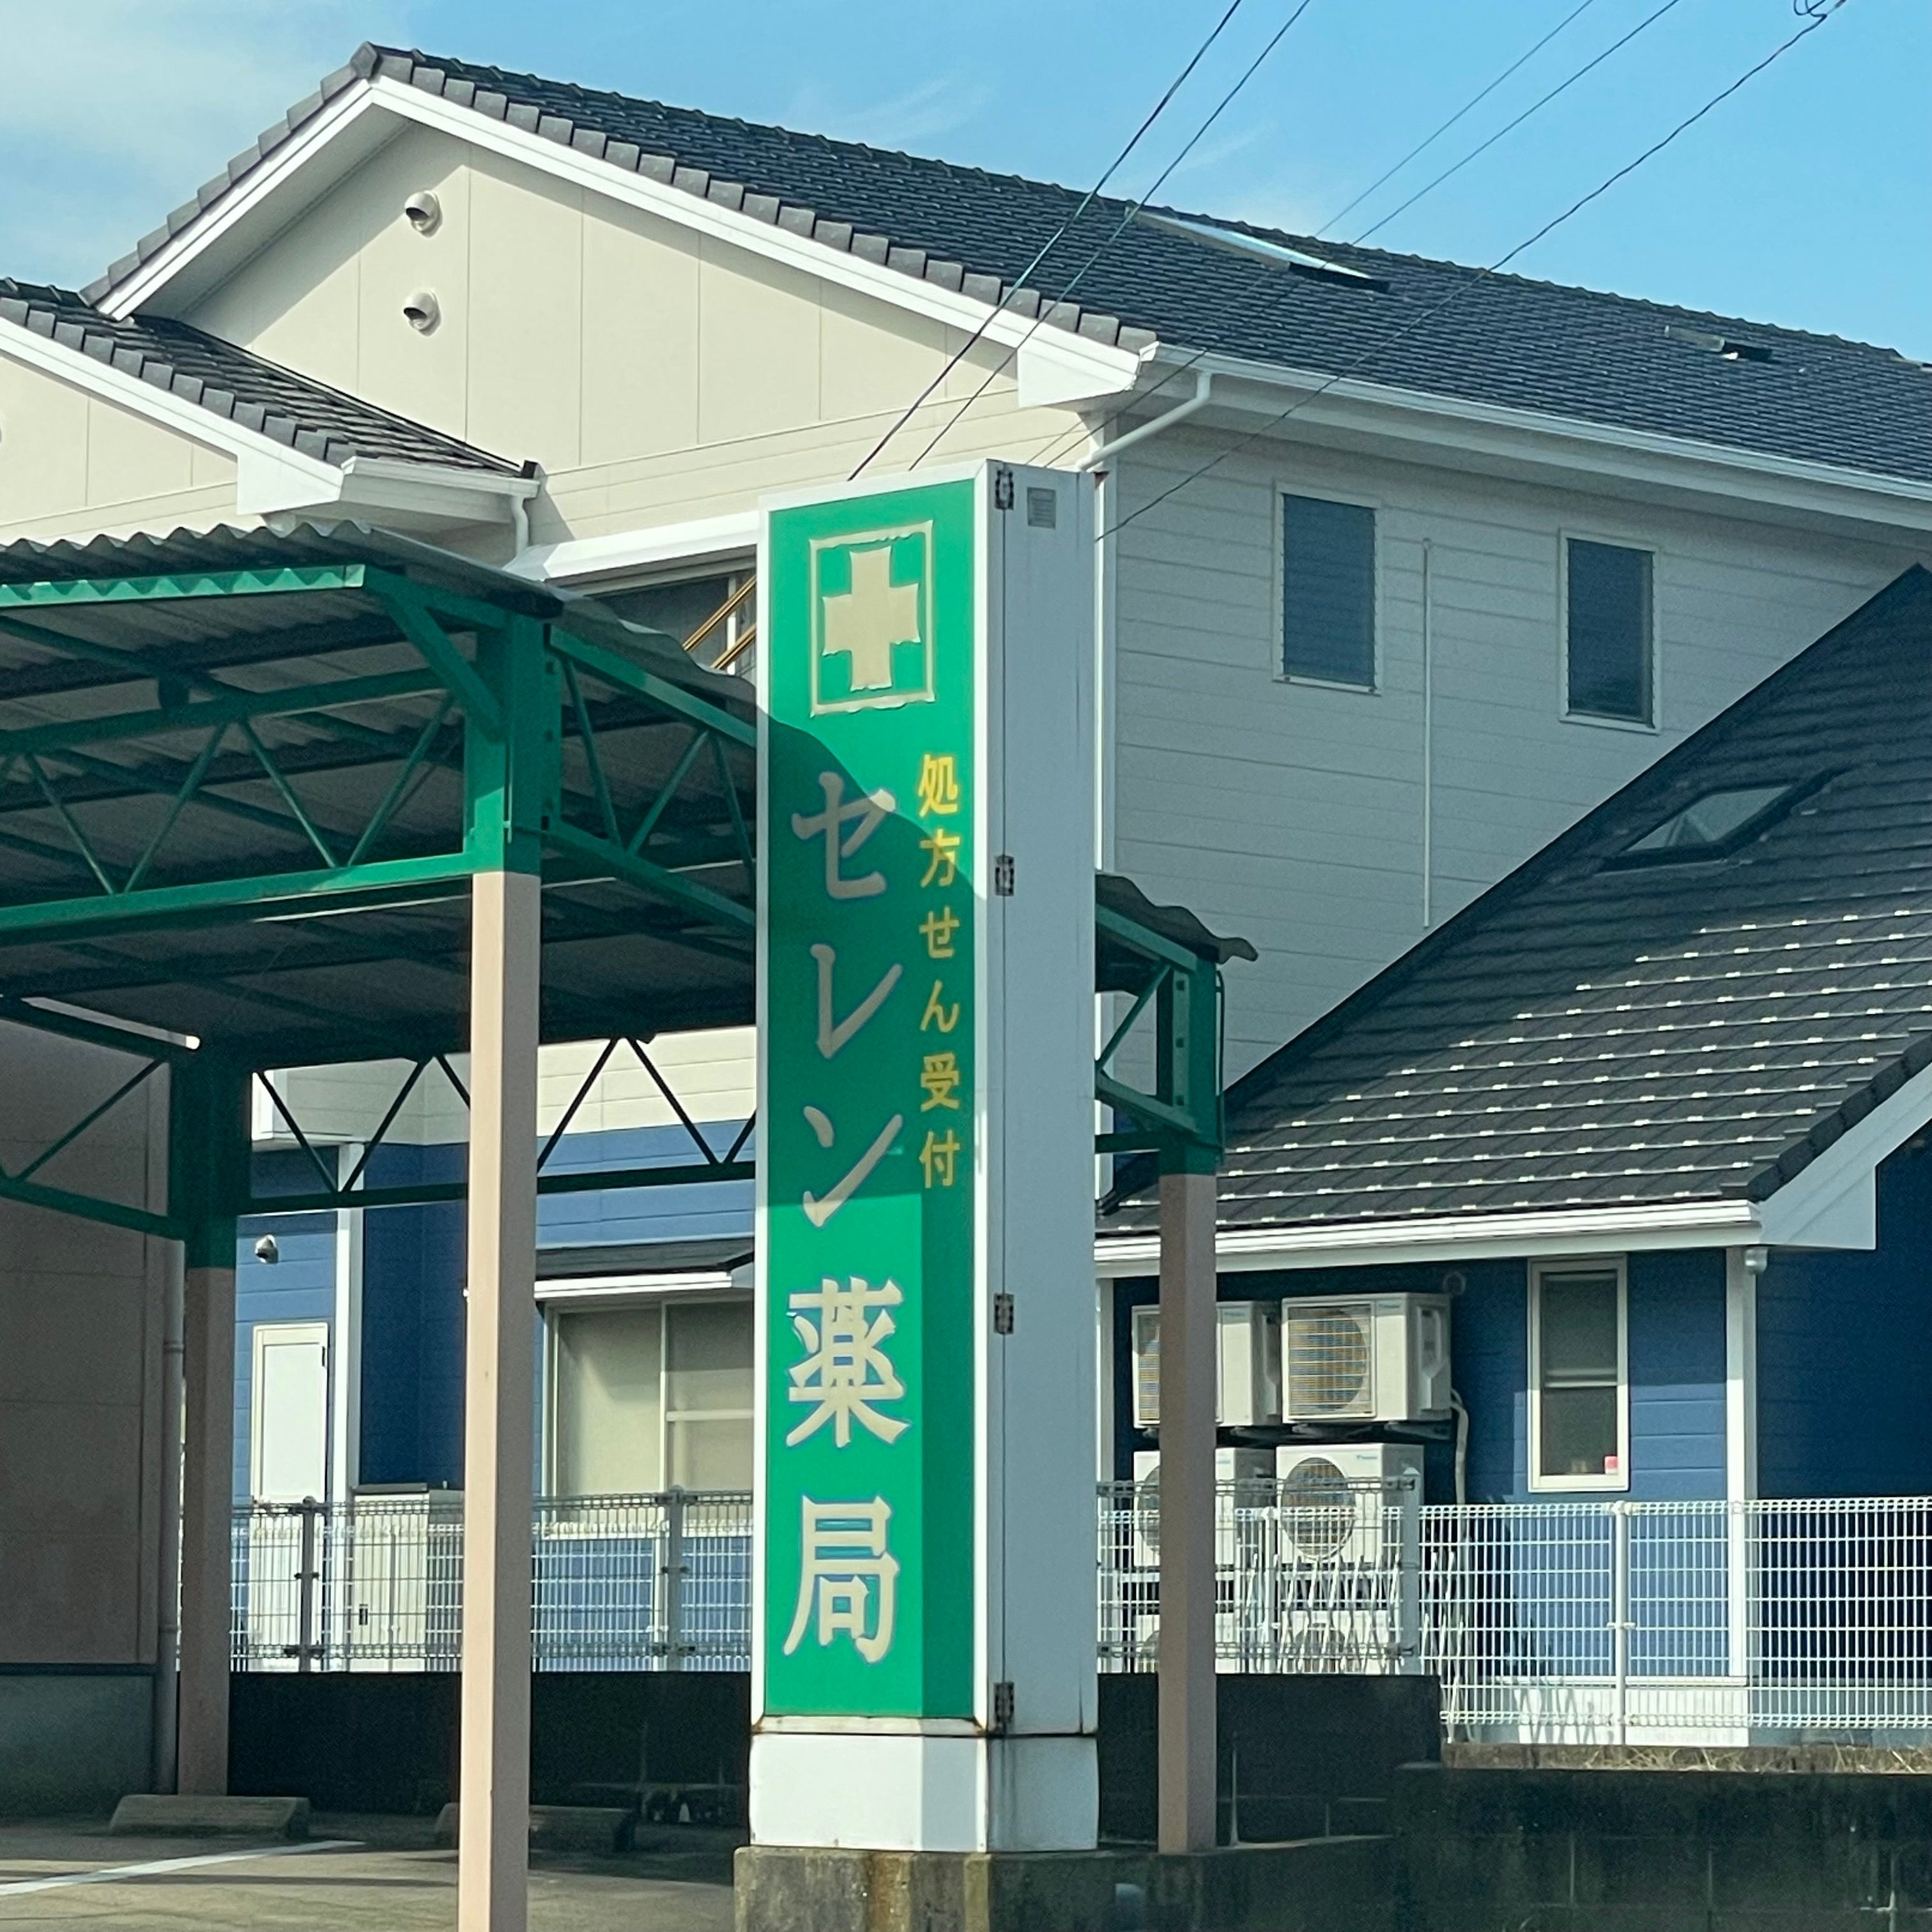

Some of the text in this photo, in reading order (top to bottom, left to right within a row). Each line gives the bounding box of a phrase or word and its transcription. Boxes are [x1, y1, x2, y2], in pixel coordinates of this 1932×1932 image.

[783, 770, 912, 1664] セレン薬局
[918, 753, 961, 1189] 処方せん受付
